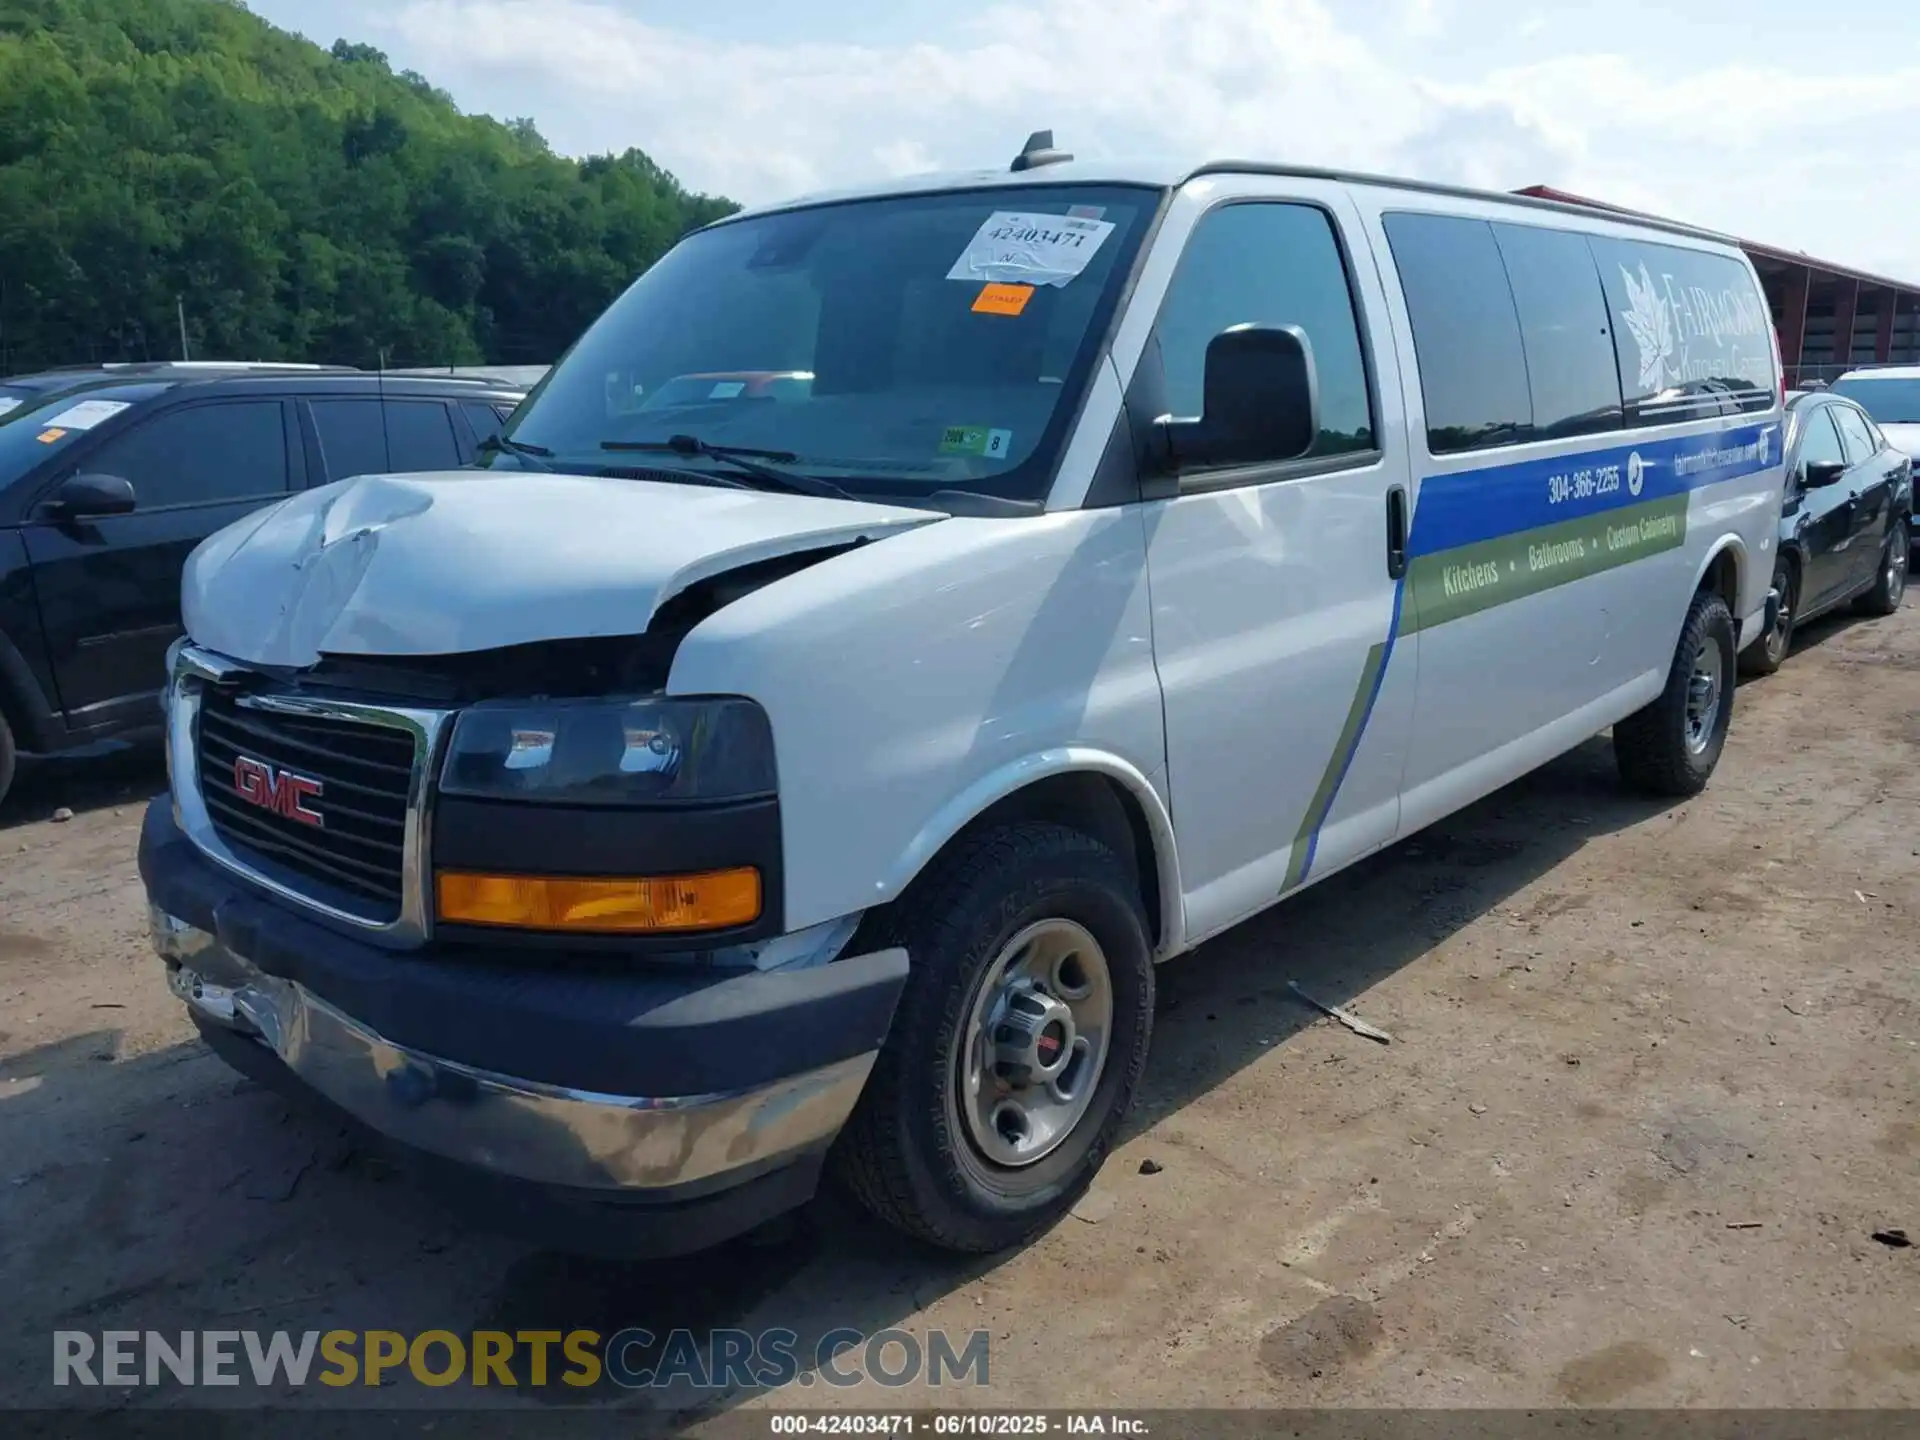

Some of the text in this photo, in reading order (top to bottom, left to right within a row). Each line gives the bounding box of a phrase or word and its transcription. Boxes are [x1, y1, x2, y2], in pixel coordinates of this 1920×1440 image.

[989, 228, 1086, 247] 42403471
[1547, 468, 1620, 505] 304-366-2255
[1442, 560, 1499, 598] Kitchens
[1528, 537, 1586, 574] Bathrooms
[1606, 525, 1640, 552] Custom
[234, 755, 324, 827] GMC
